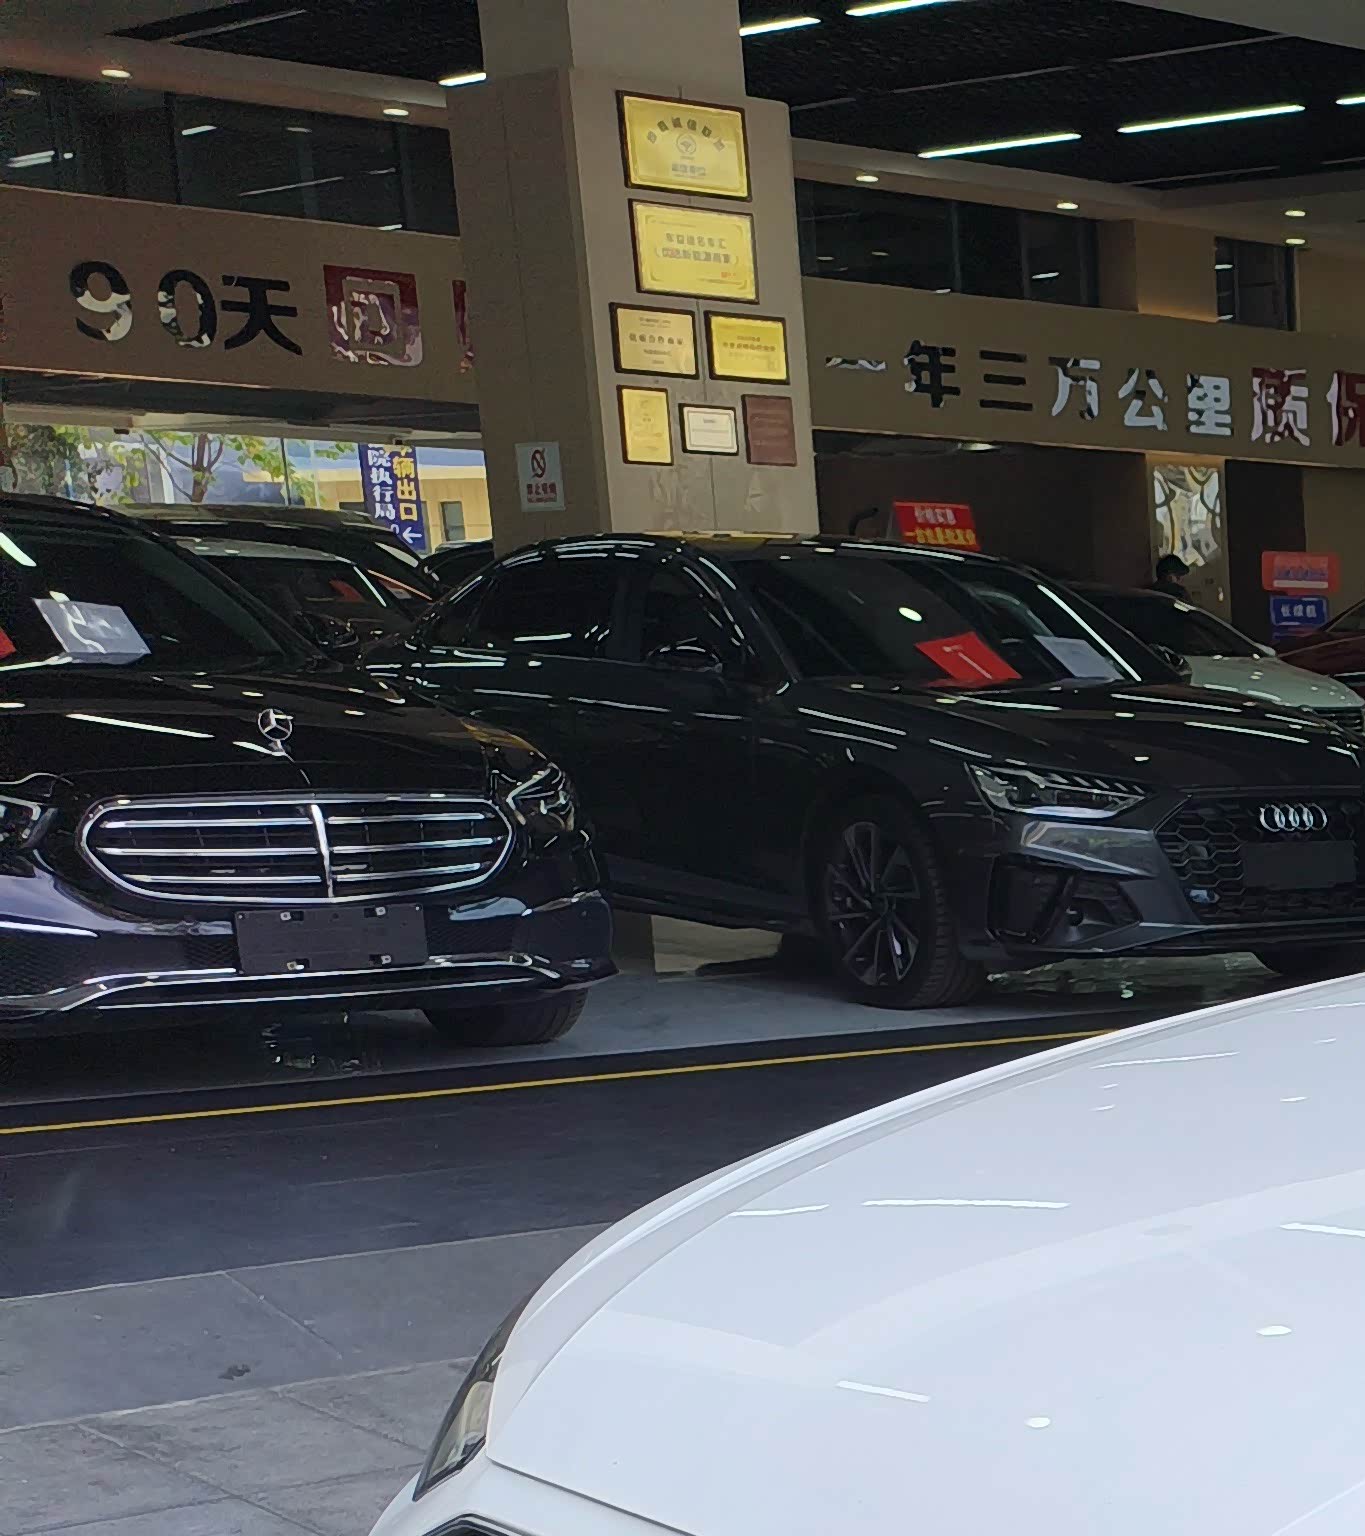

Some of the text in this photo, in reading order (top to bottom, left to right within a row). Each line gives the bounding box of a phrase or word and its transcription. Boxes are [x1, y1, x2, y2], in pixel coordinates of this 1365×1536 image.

[68, 259, 474, 374] 90天回
[366, 442, 396, 521] 院执行局
